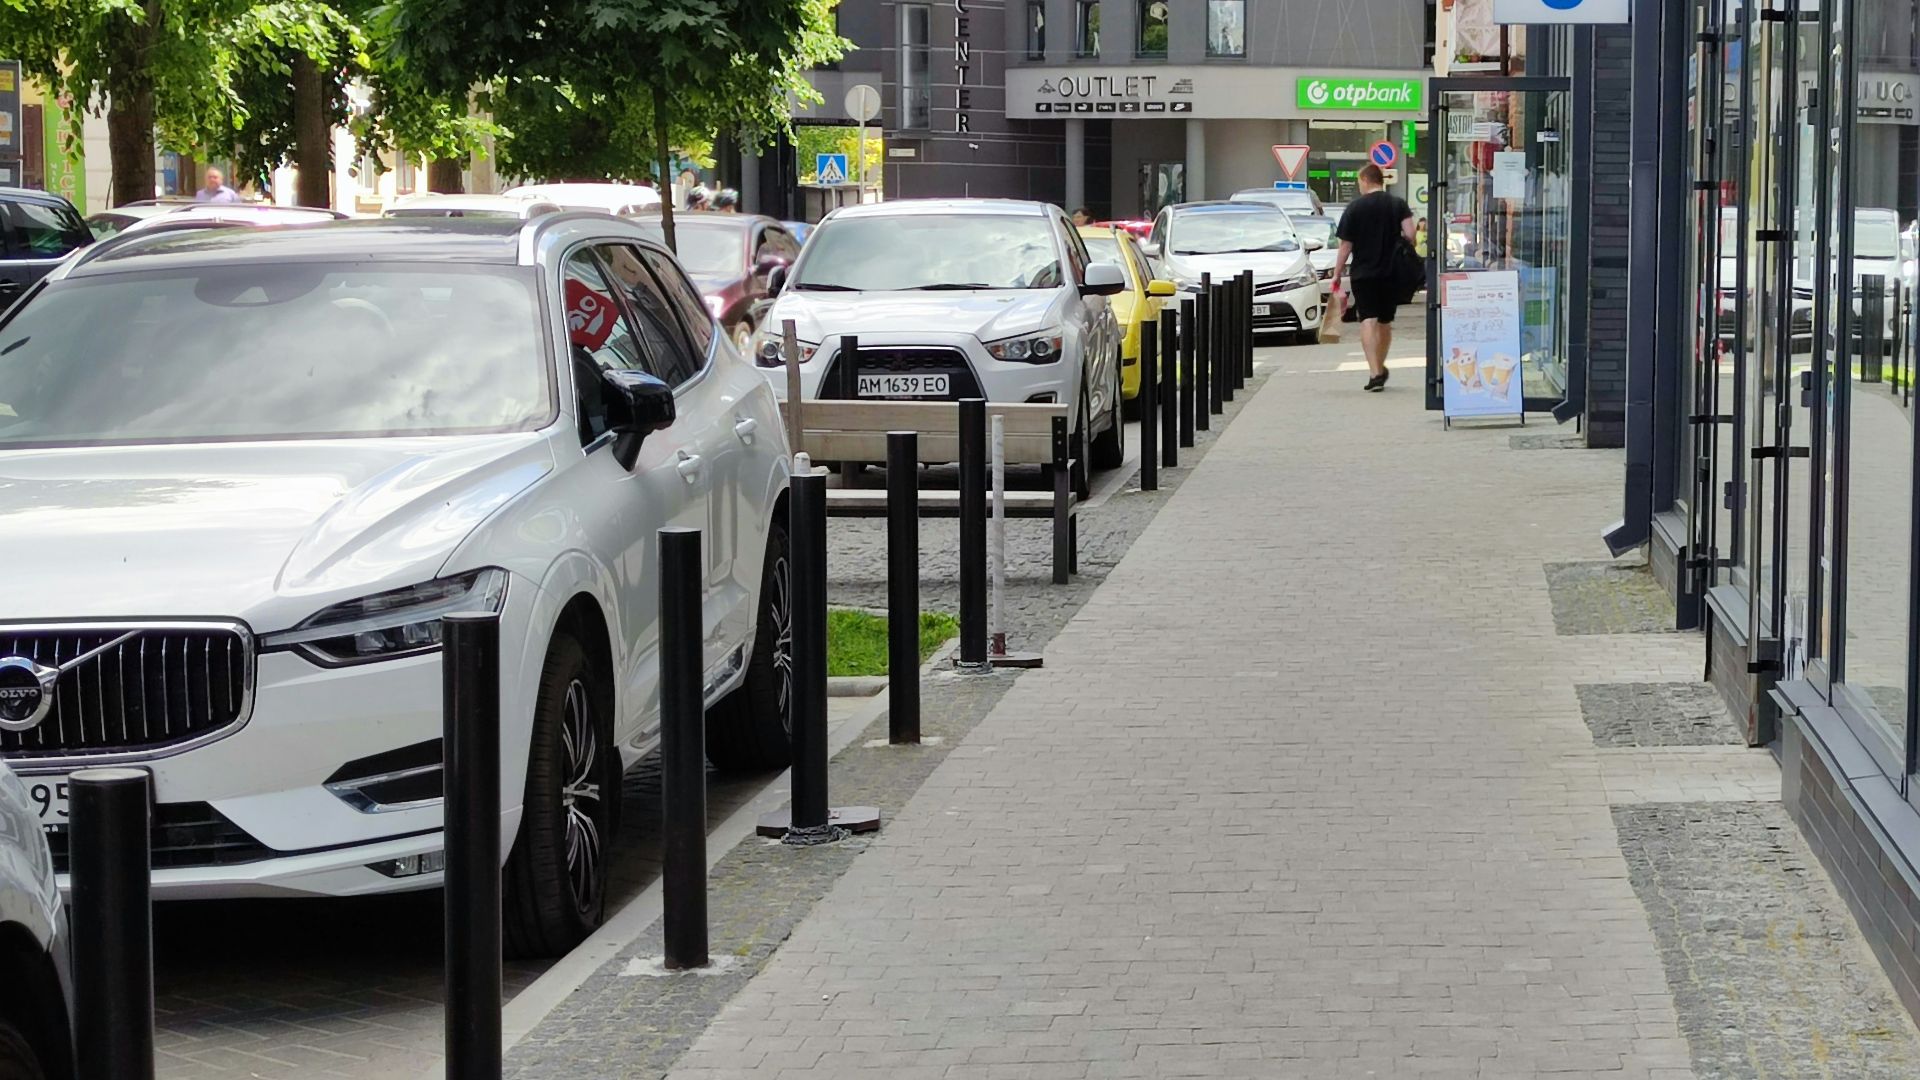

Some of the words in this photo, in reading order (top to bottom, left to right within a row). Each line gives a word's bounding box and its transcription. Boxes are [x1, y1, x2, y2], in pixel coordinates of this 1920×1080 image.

[1058, 76, 1157, 97] OUTLET
[1333, 81, 1412, 106] otpbank
[859, 378, 881, 393] AM
[884, 377, 919, 393] 1639
[923, 377, 946, 392] EO
[0, 689, 38, 698] OLVO
